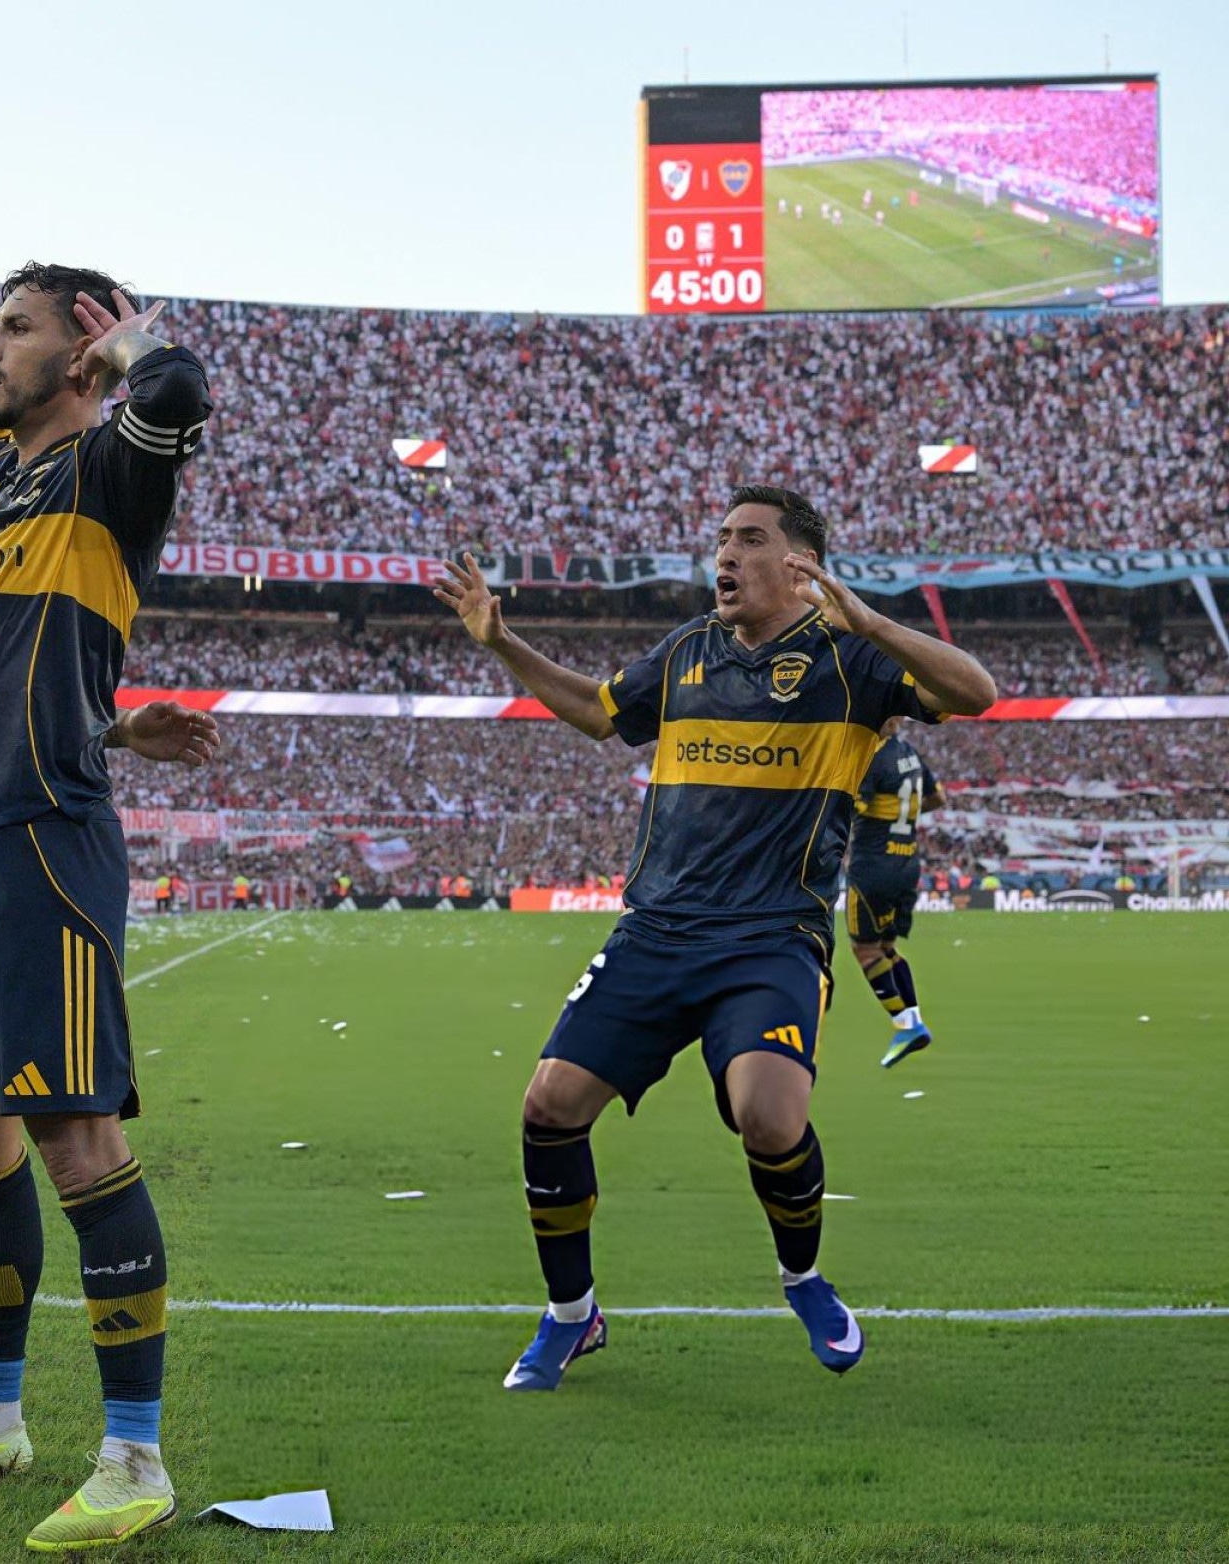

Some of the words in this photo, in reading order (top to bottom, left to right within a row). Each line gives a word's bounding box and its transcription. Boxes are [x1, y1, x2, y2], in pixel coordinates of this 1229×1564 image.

[665, 224, 685, 251] 0
[729, 223, 743, 249] 1
[650, 268, 762, 305] 45:00
[676, 737, 800, 767] betsson
